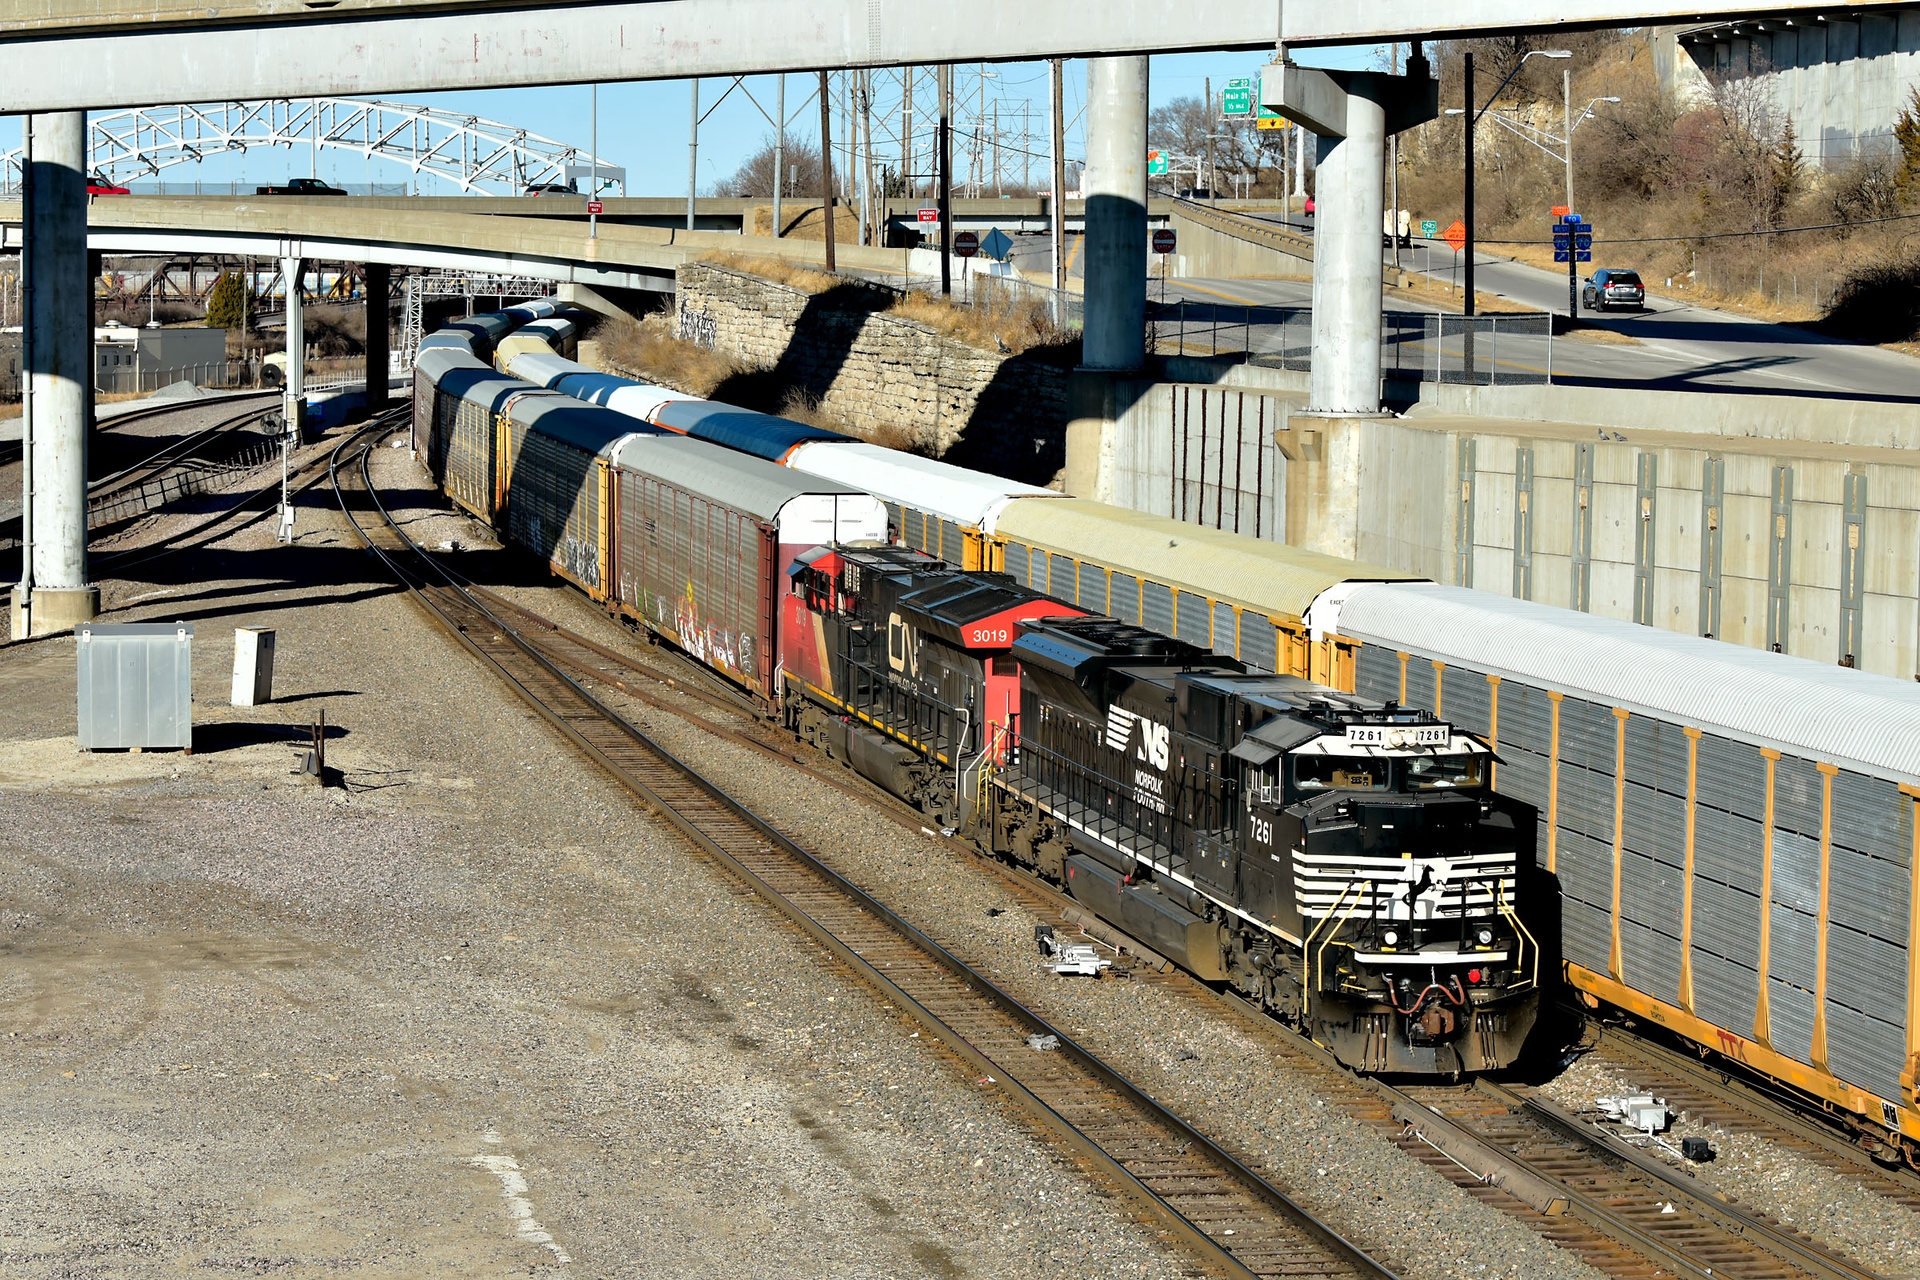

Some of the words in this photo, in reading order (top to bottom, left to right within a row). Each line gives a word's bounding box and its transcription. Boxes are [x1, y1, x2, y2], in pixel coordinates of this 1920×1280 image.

[1555, 239, 1568, 248] 70
[1578, 239, 1590, 248] 70
[796, 605, 807, 627] 3019
[973, 629, 1007, 642] 3019
[888, 612, 917, 678] CN
[1350, 730, 1382, 741] 7261
[1420, 730, 1446, 741] 7261
[1134, 769, 1163, 795] NORFOLK
[1250, 815, 1273, 847] 7261
[1716, 1029, 1749, 1064] TTX
